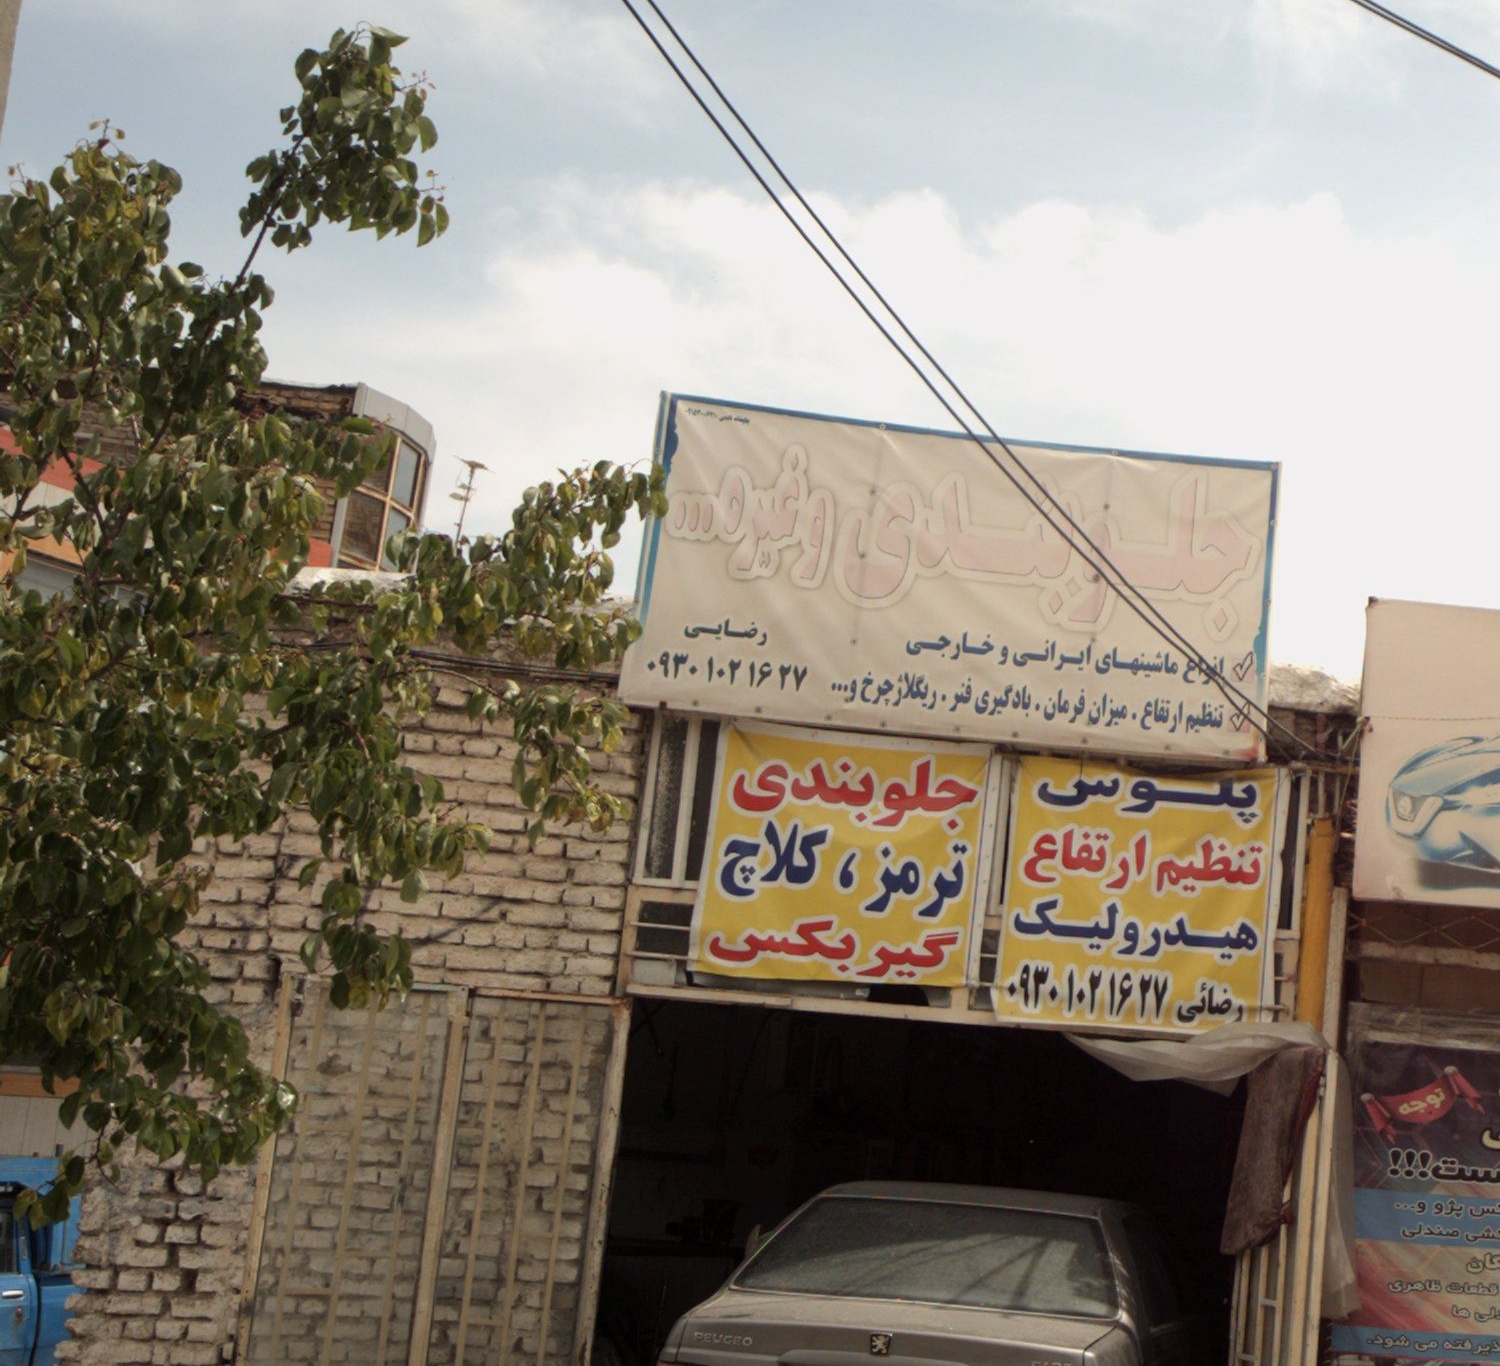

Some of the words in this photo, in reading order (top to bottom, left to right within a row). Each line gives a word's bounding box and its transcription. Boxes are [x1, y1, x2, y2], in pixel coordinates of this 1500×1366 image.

[684, 618, 768, 646] رضایی
[906, 632, 995, 660] خارجی
[999, 645, 1008, 665] و
[1012, 639, 1092, 671] ایرانی
[948, 677, 973, 712] فنر
[974, 684, 1032, 718] بادگیری
[1043, 688, 1086, 723] فرمان
[1088, 693, 1128, 727] میزان
[1139, 697, 1184, 733] ارتفاع
[1185, 701, 1225, 734] تنظیم
[732, 759, 979, 830] جلوبندی
[1037, 776, 1259, 824] پلوس
[719, 820, 830, 897] کلاچ
[1023, 828, 1148, 890] ارتفاع
[1156, 838, 1264, 892] تنظیم
[864, 842, 968, 918] ترمز
[1013, 898, 1259, 960] هیدرولیک
[1398, 1087, 1447, 1117] توجه
[1433, 1199, 1464, 1218] پژو
[1401, 1223, 1460, 1239] صندلی
[1414, 1339, 1439, 1352] می
